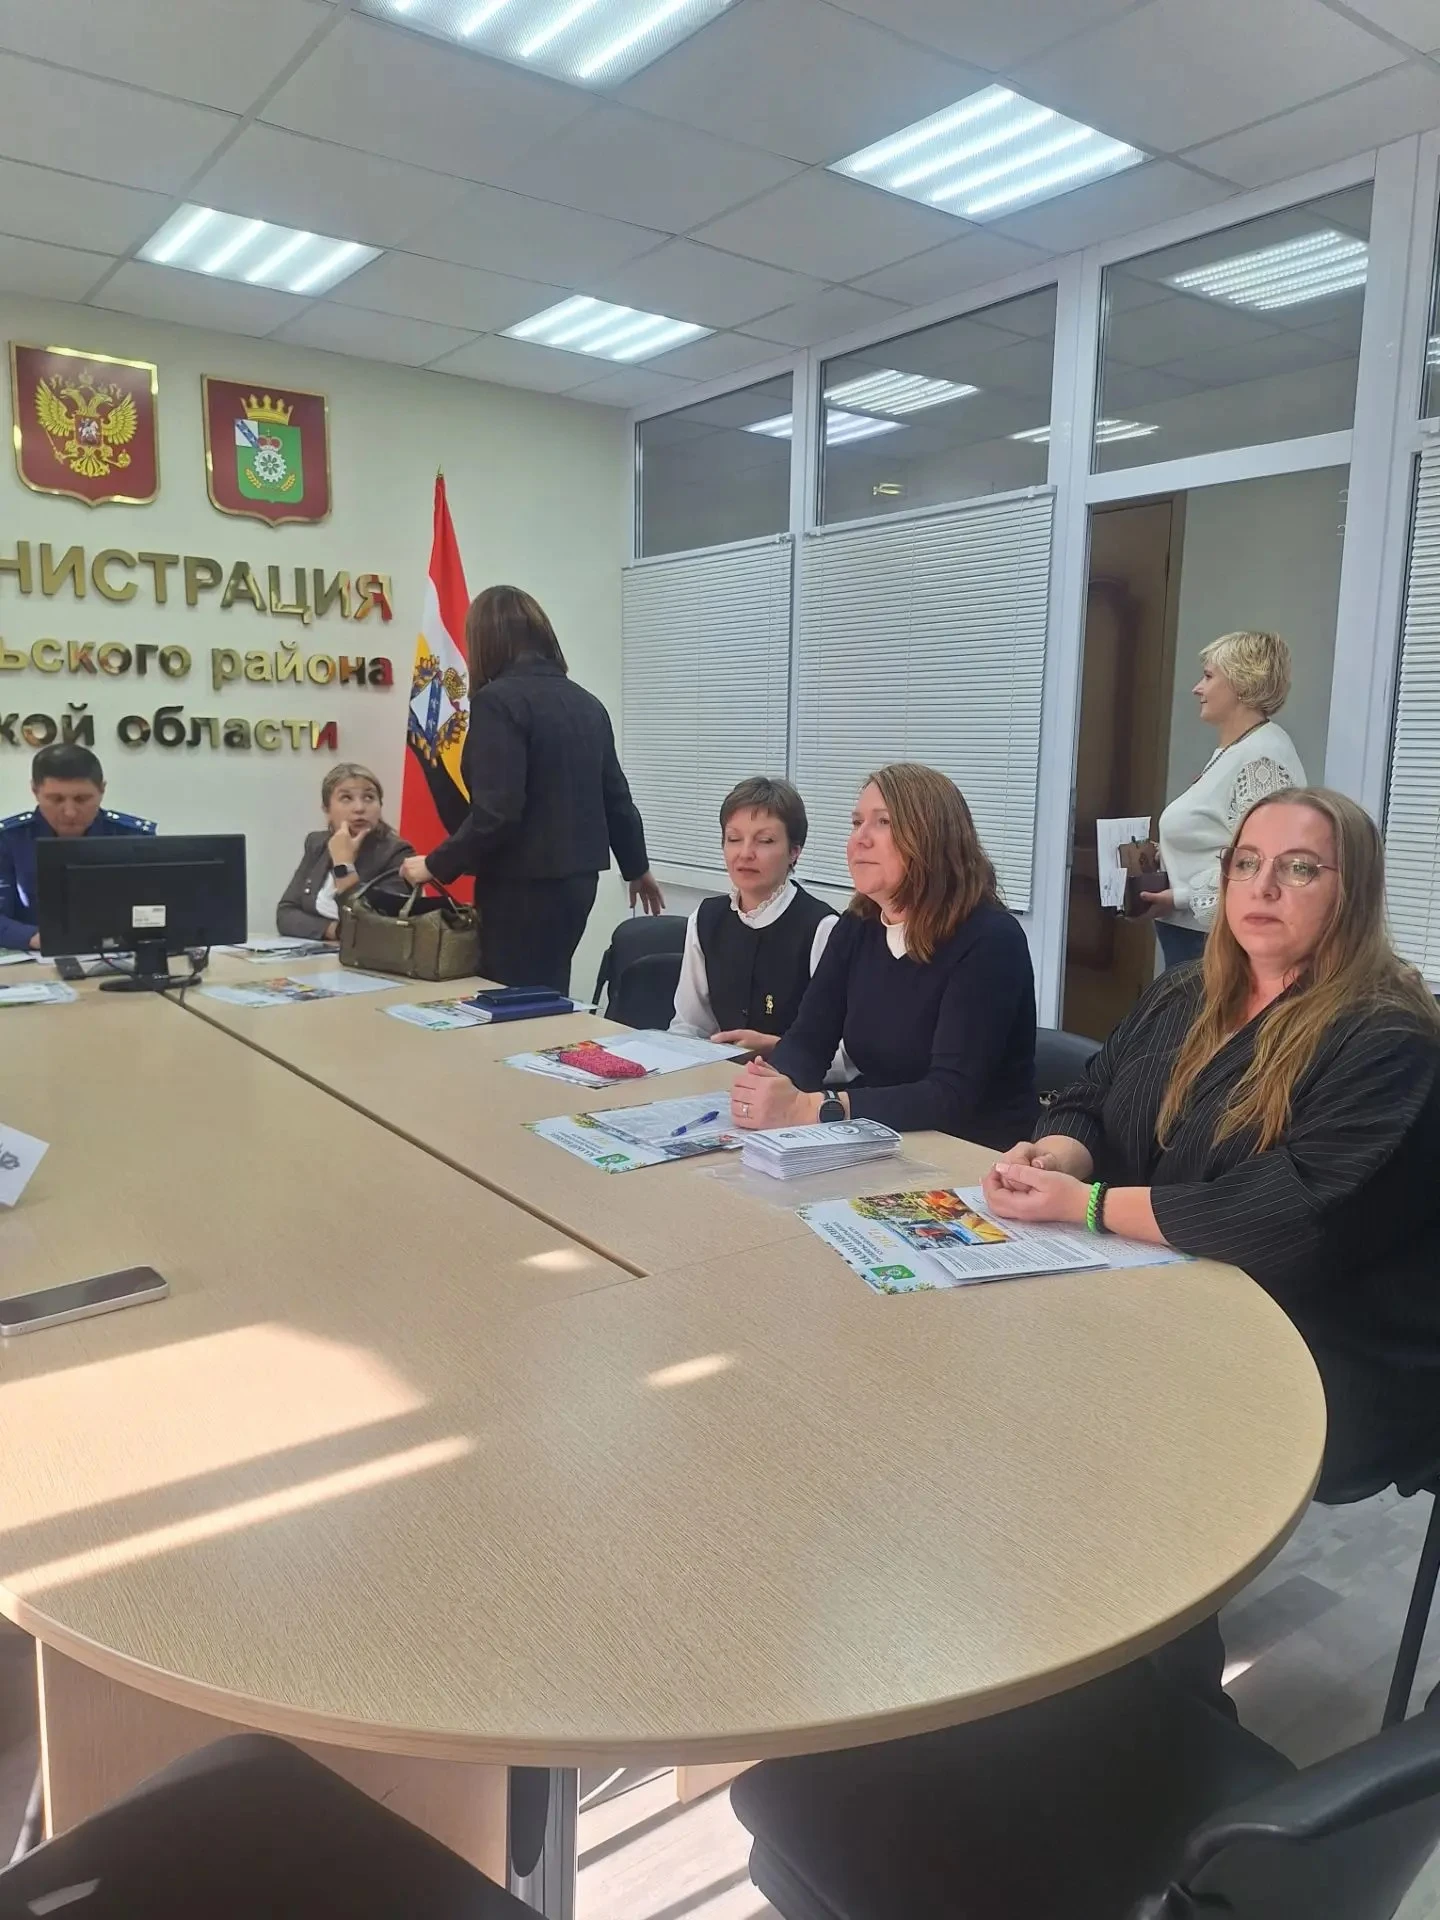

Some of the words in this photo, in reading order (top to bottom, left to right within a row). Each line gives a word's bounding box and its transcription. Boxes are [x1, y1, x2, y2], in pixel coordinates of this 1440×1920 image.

[0, 637, 192, 678] ьского
[211, 640, 394, 691] района
[117, 706, 339, 751] области
